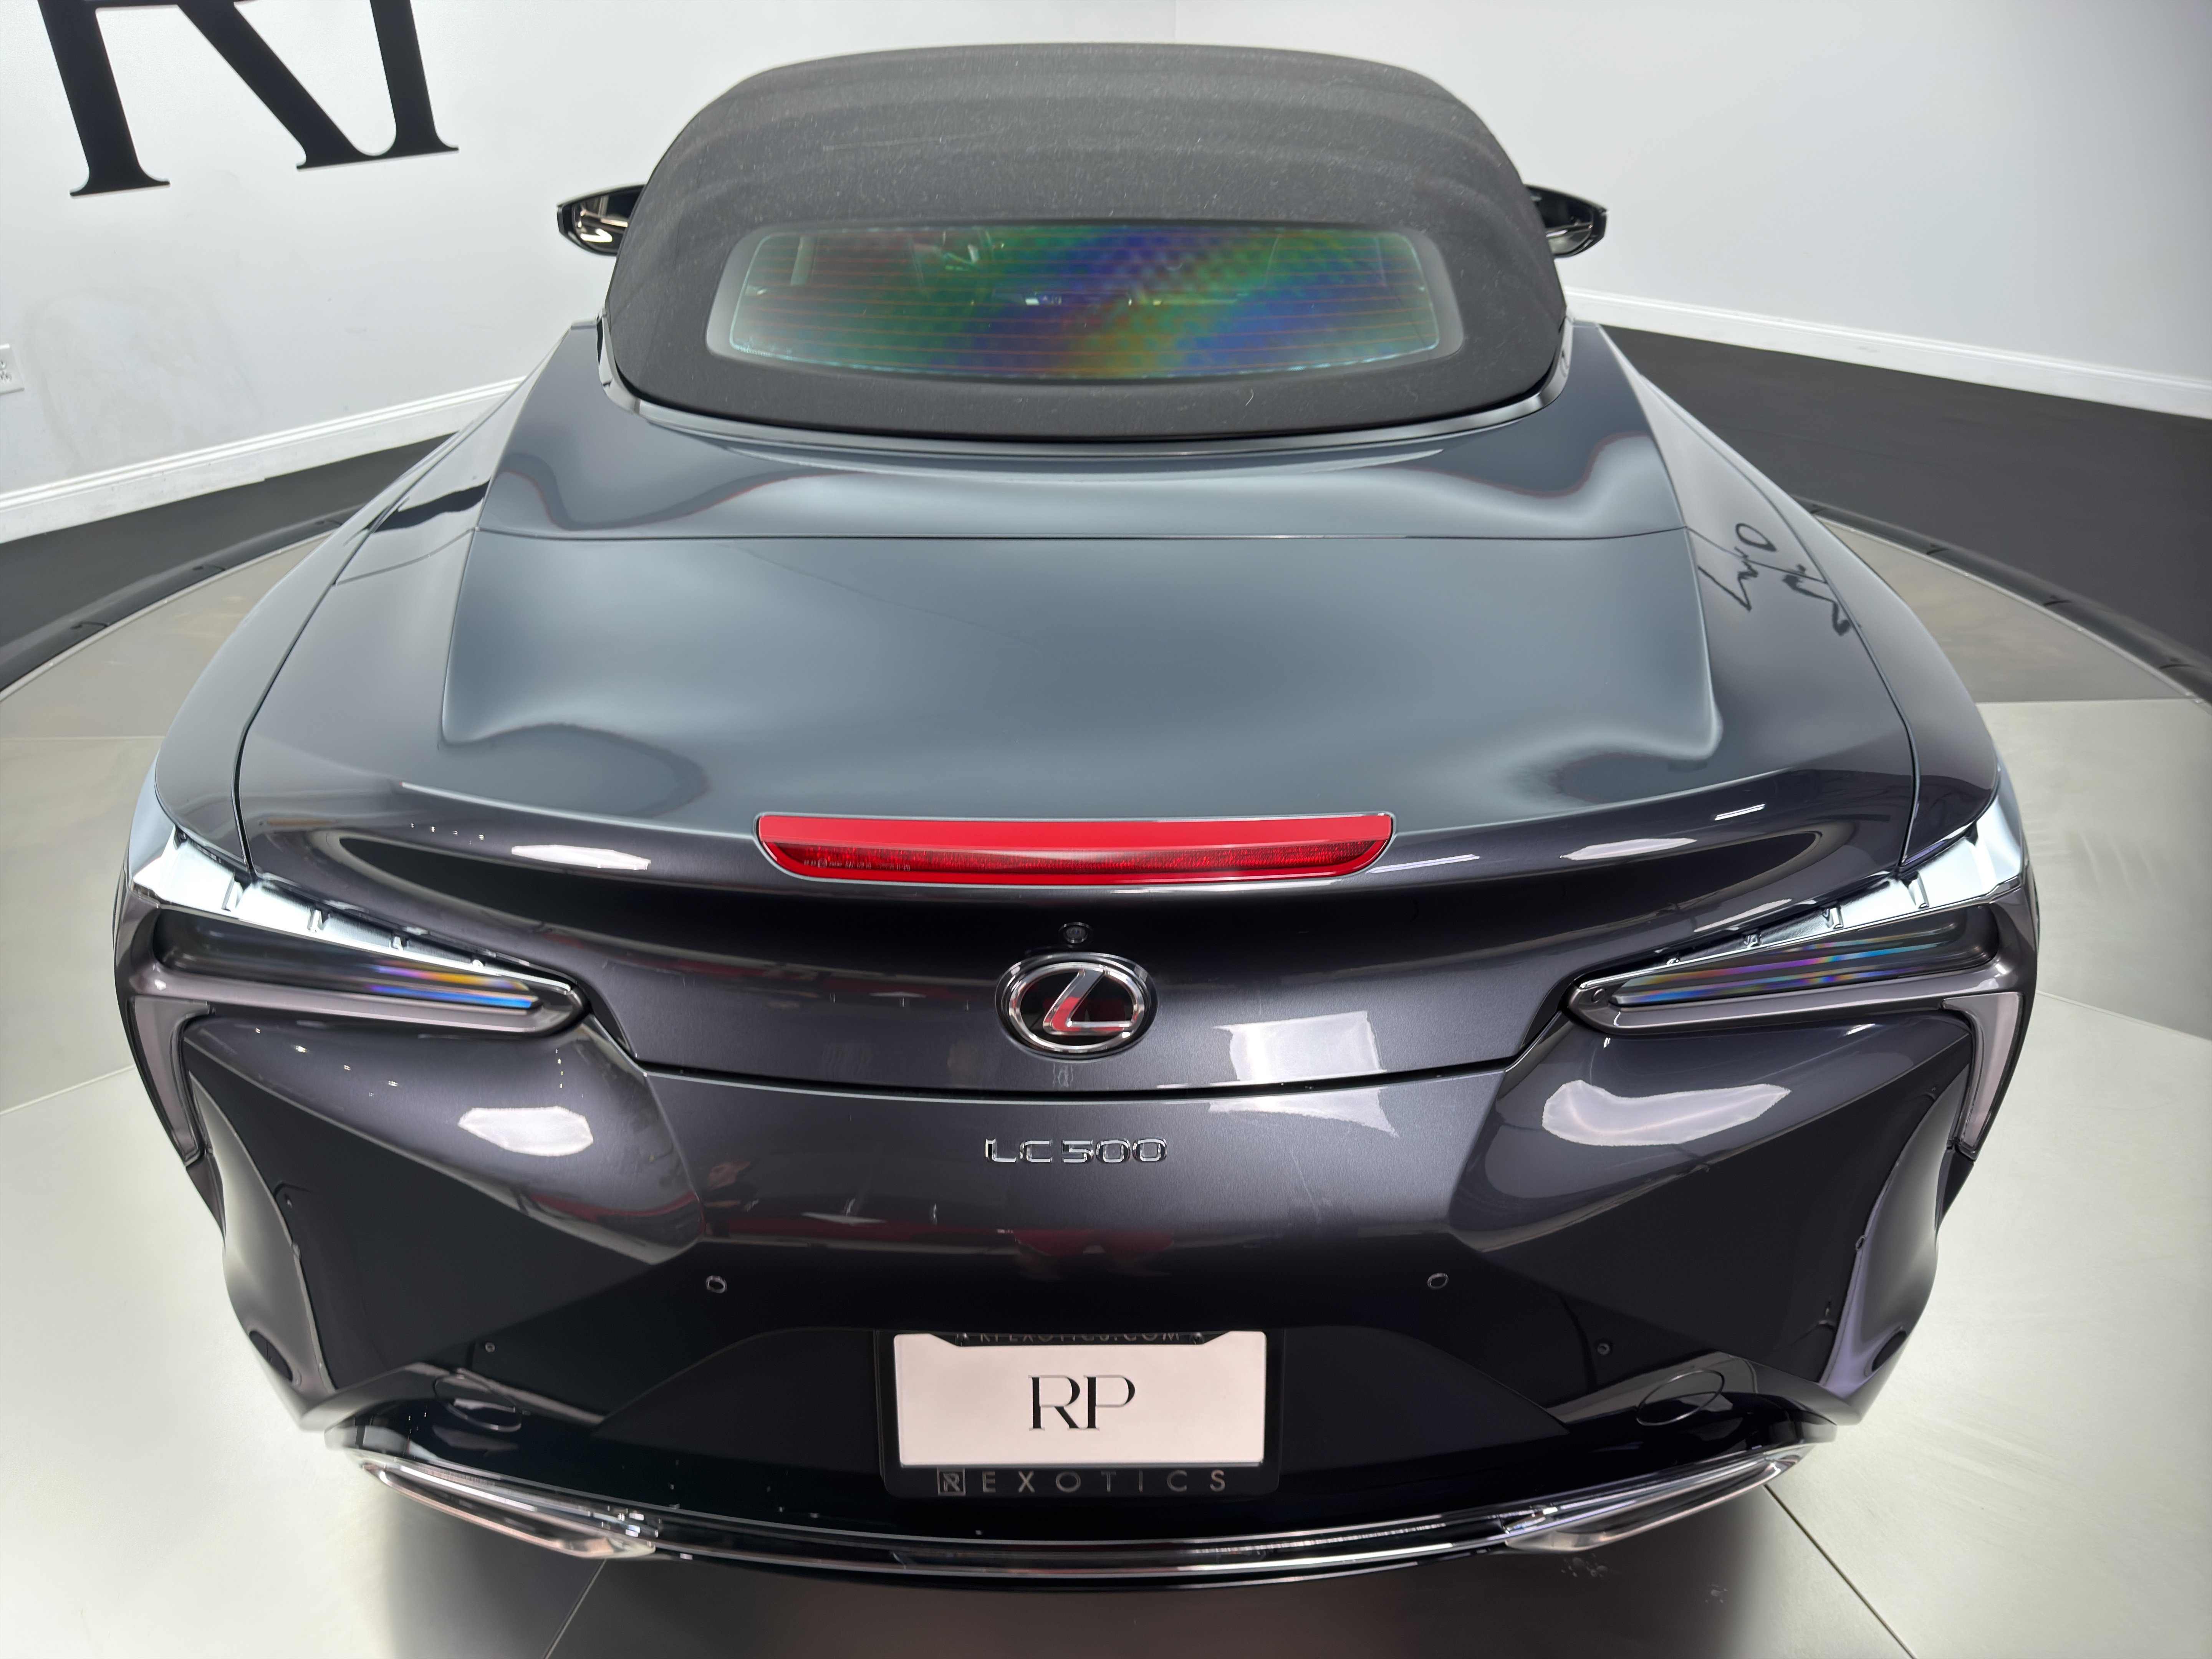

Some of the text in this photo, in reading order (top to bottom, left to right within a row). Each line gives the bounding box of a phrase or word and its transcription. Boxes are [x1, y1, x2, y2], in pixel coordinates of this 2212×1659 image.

[984, 1137, 1167, 1163] LC 500
[1028, 1374, 1135, 1431] RP
[982, 1469, 1226, 1493] EXOTICS
